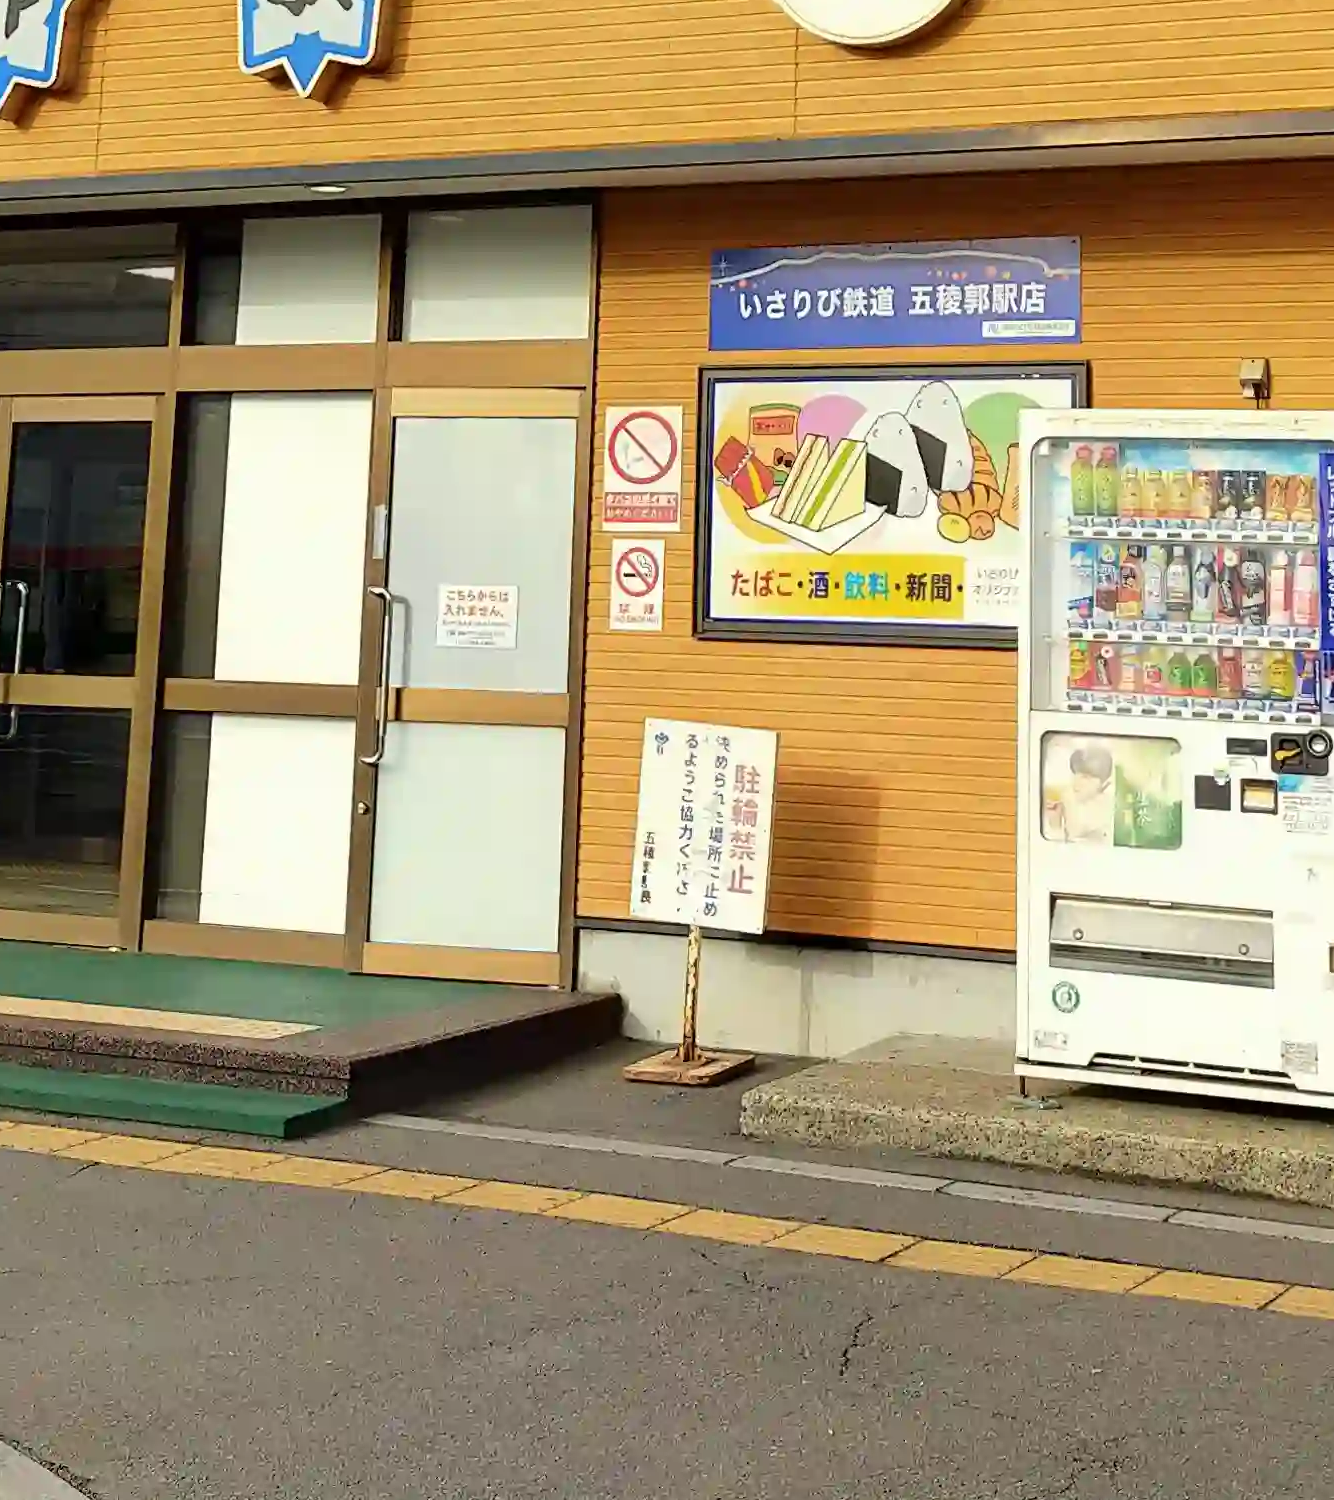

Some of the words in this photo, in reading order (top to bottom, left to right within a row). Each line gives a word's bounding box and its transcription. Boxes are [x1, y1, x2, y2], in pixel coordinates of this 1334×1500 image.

[738, 285, 896, 320] いさりび鉄道
[907, 281, 1047, 317] 五稜郭駅店
[446, 589, 510, 603] こちらからは
[727, 764, 762, 896] 駐輪禁止
